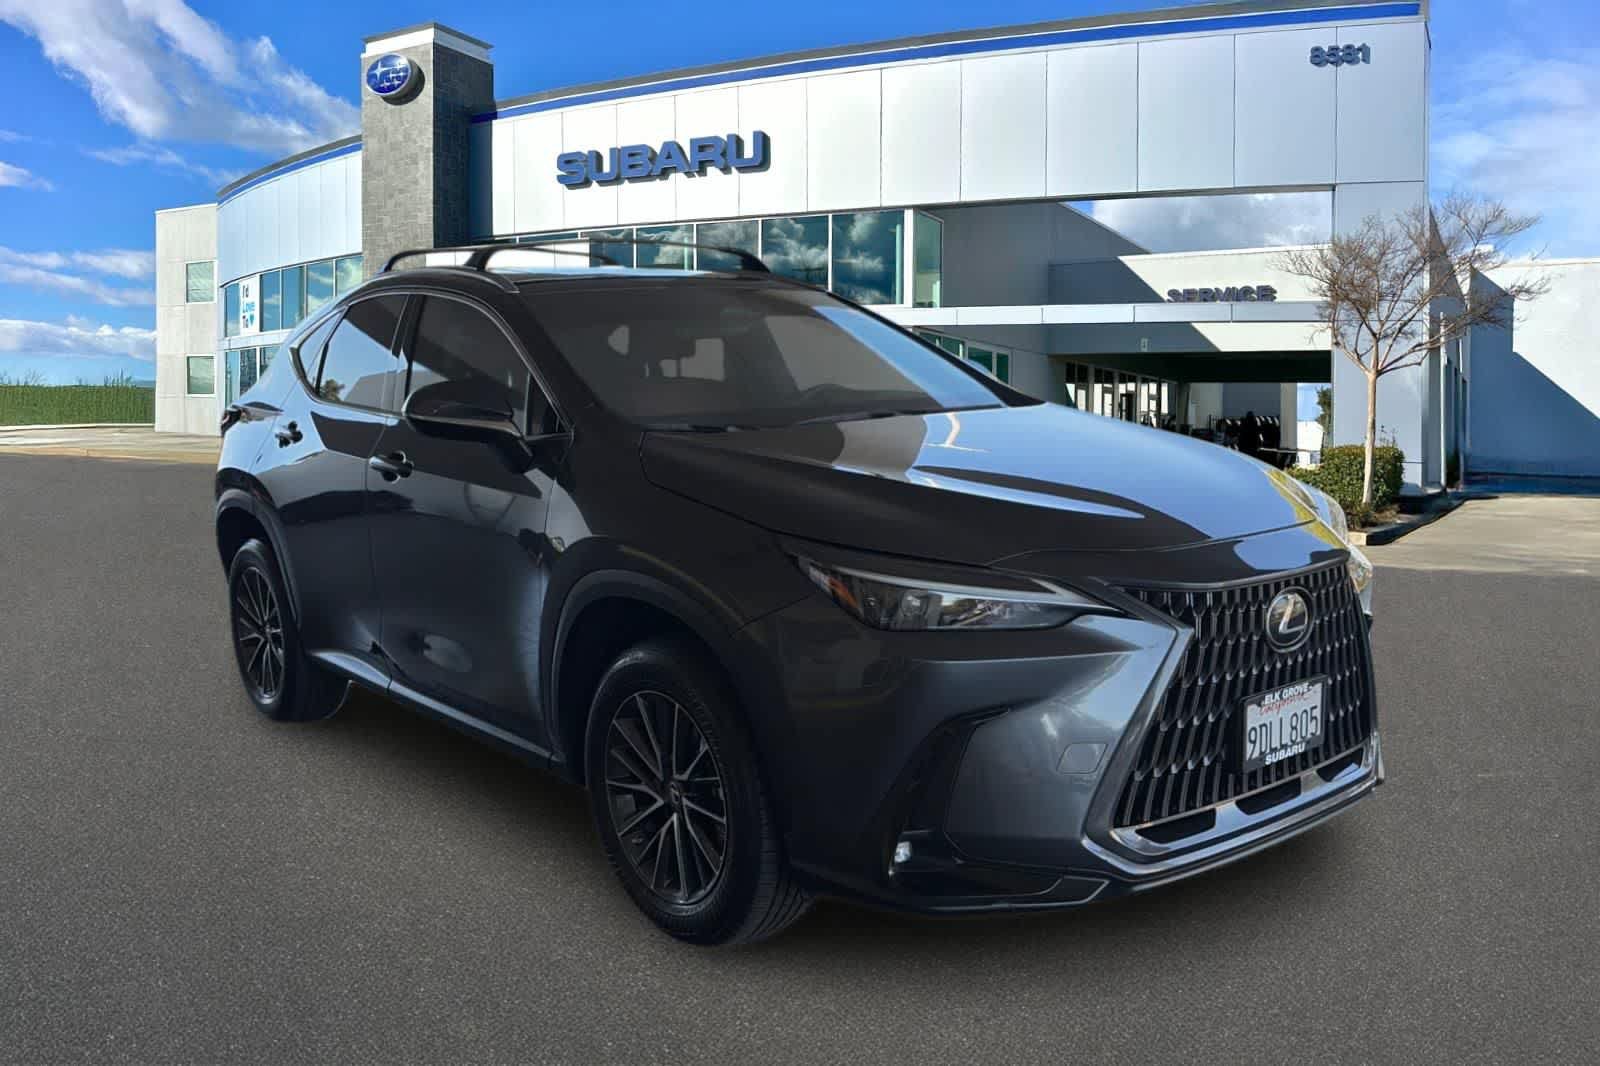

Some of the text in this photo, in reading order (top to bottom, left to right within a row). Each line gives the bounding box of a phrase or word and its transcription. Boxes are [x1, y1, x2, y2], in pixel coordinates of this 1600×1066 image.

[557, 130, 769, 188] SUBARU
[1167, 285, 1277, 303] SERVICE
[1264, 682, 1309, 705] ELK GROVE
[1247, 704, 1319, 760] 9DLL805
[1265, 742, 1306, 765] SUBARU
